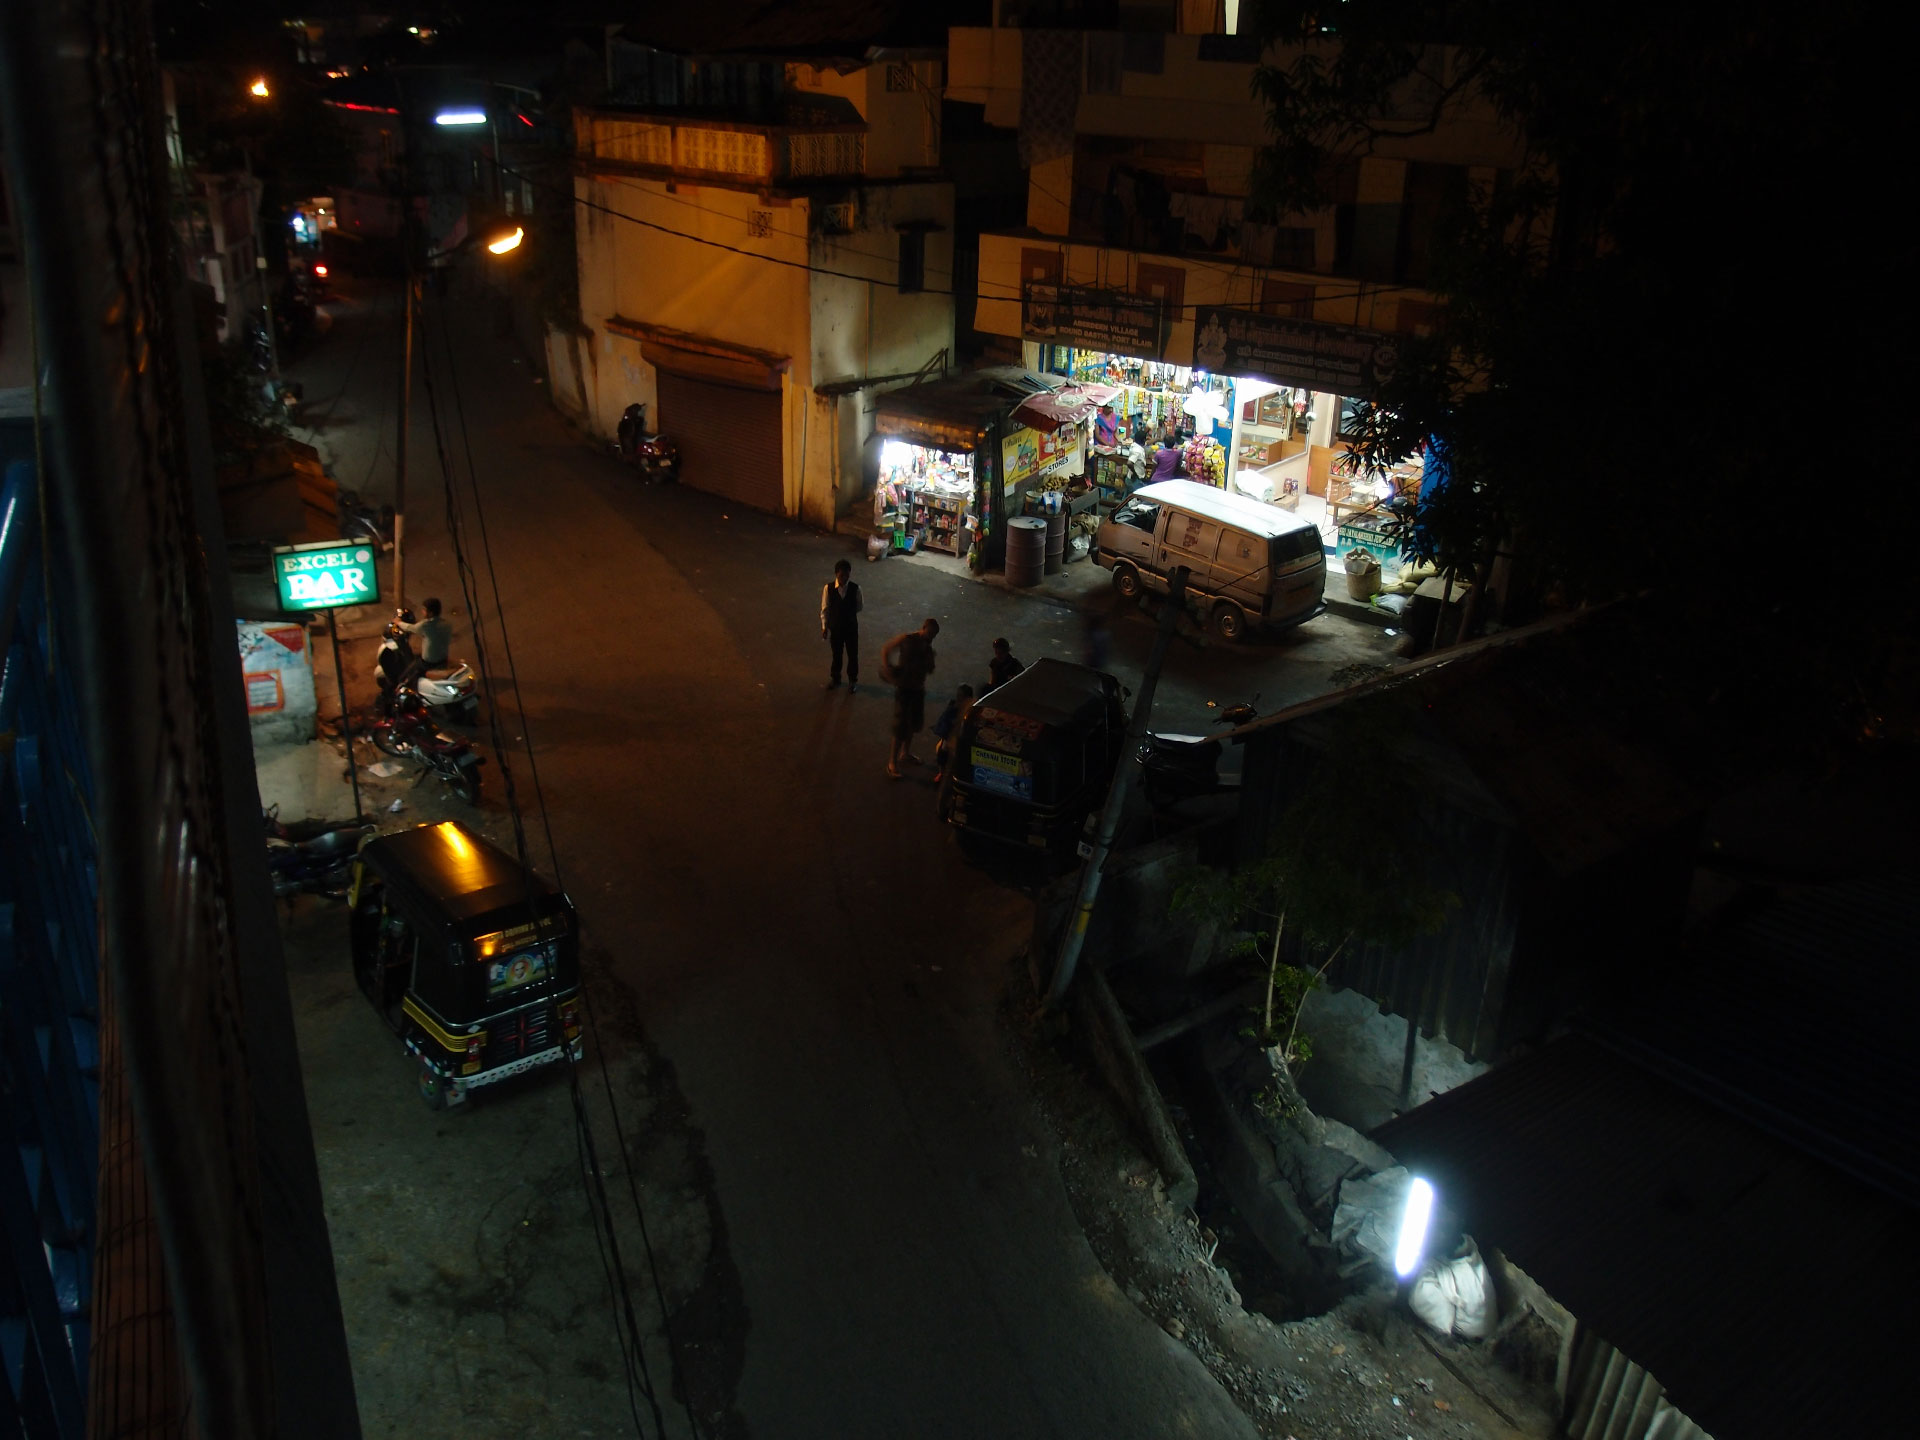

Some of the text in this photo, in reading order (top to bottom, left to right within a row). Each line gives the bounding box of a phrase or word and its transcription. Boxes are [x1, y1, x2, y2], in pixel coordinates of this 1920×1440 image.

[1059, 325, 1082, 337] ROUND
[1111, 334, 1130, 344] PORT
[1131, 337, 1152, 348] BLAIR
[1073, 319, 1139, 337] ABERDEEN VILLAGE
[1048, 456, 1069, 473] STORES
[282, 552, 354, 573] EXCEL
[287, 568, 369, 600] BAR
